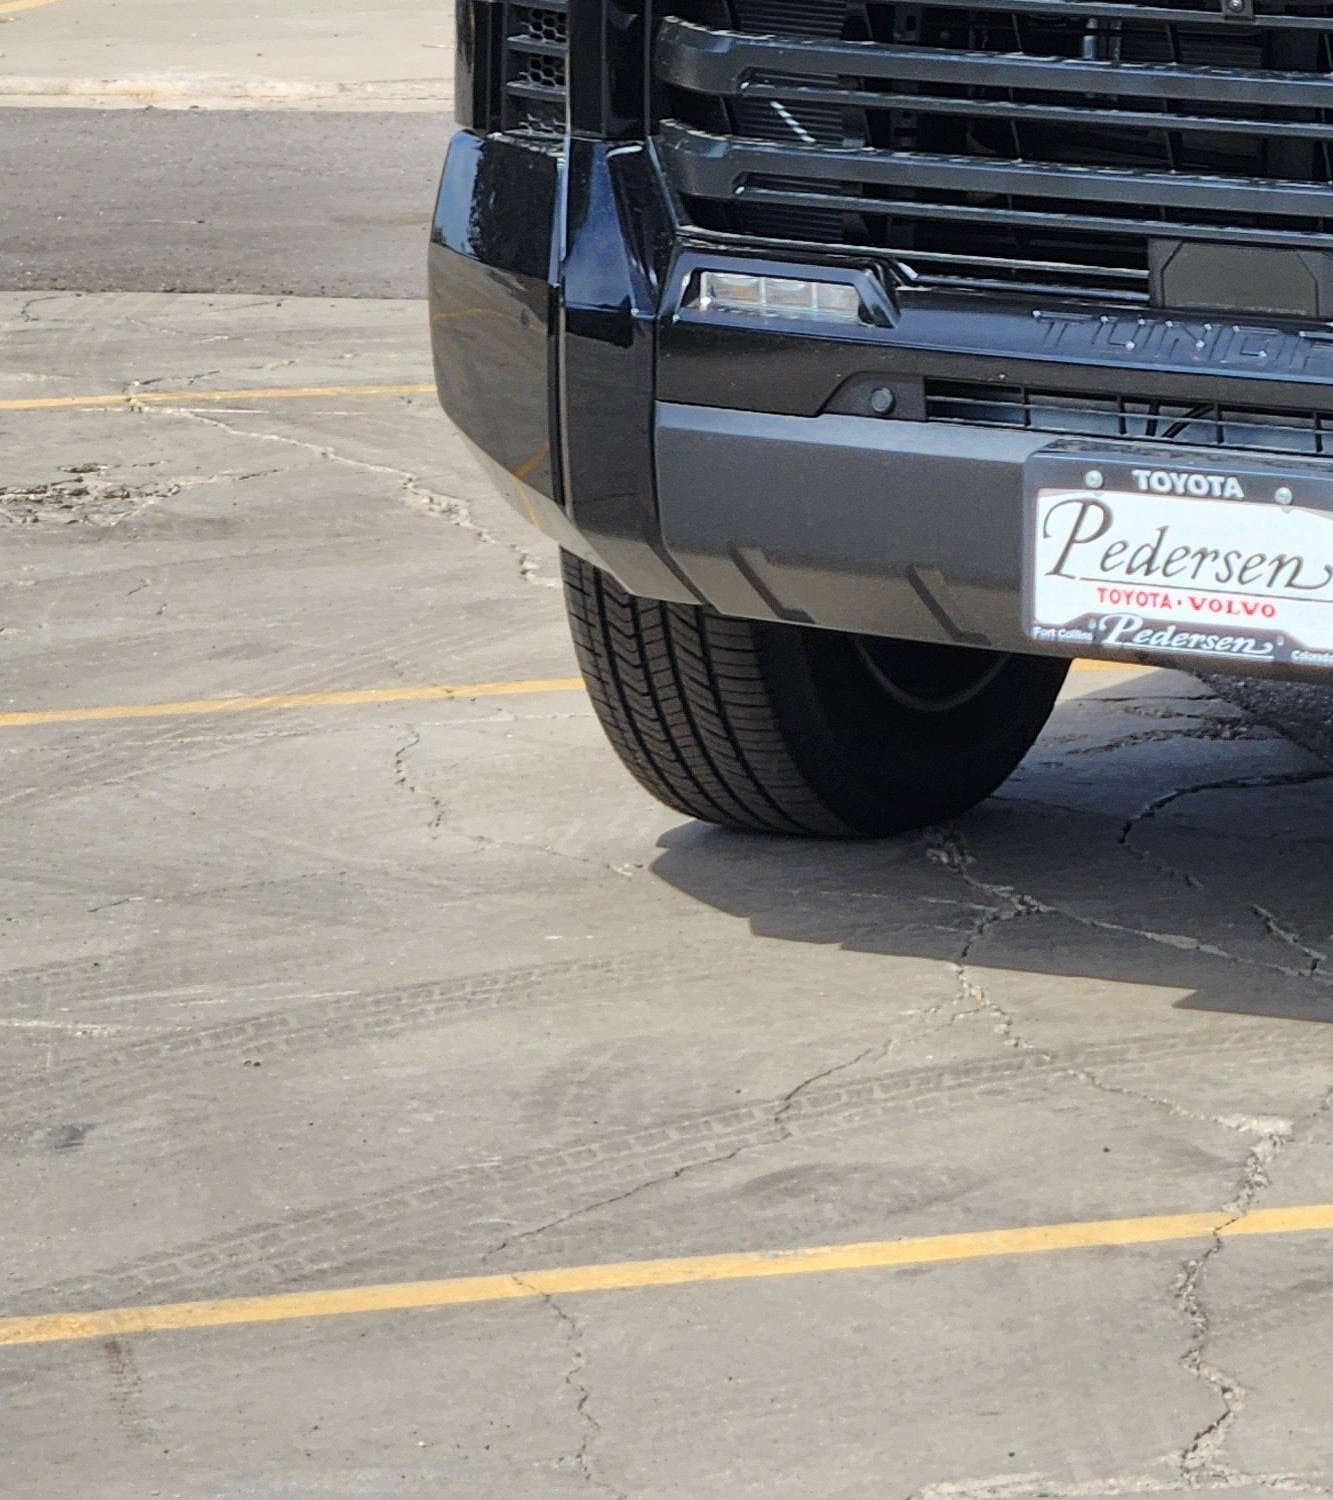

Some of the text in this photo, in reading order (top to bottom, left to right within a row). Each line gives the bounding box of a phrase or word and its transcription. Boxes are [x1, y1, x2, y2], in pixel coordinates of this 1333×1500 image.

[1132, 470, 1244, 499] TOYOTA
[1043, 498, 1333, 590] Pedersen
[1096, 587, 1276, 618] TOYOTA VOLVO
[1098, 613, 1273, 655] Pedersen
